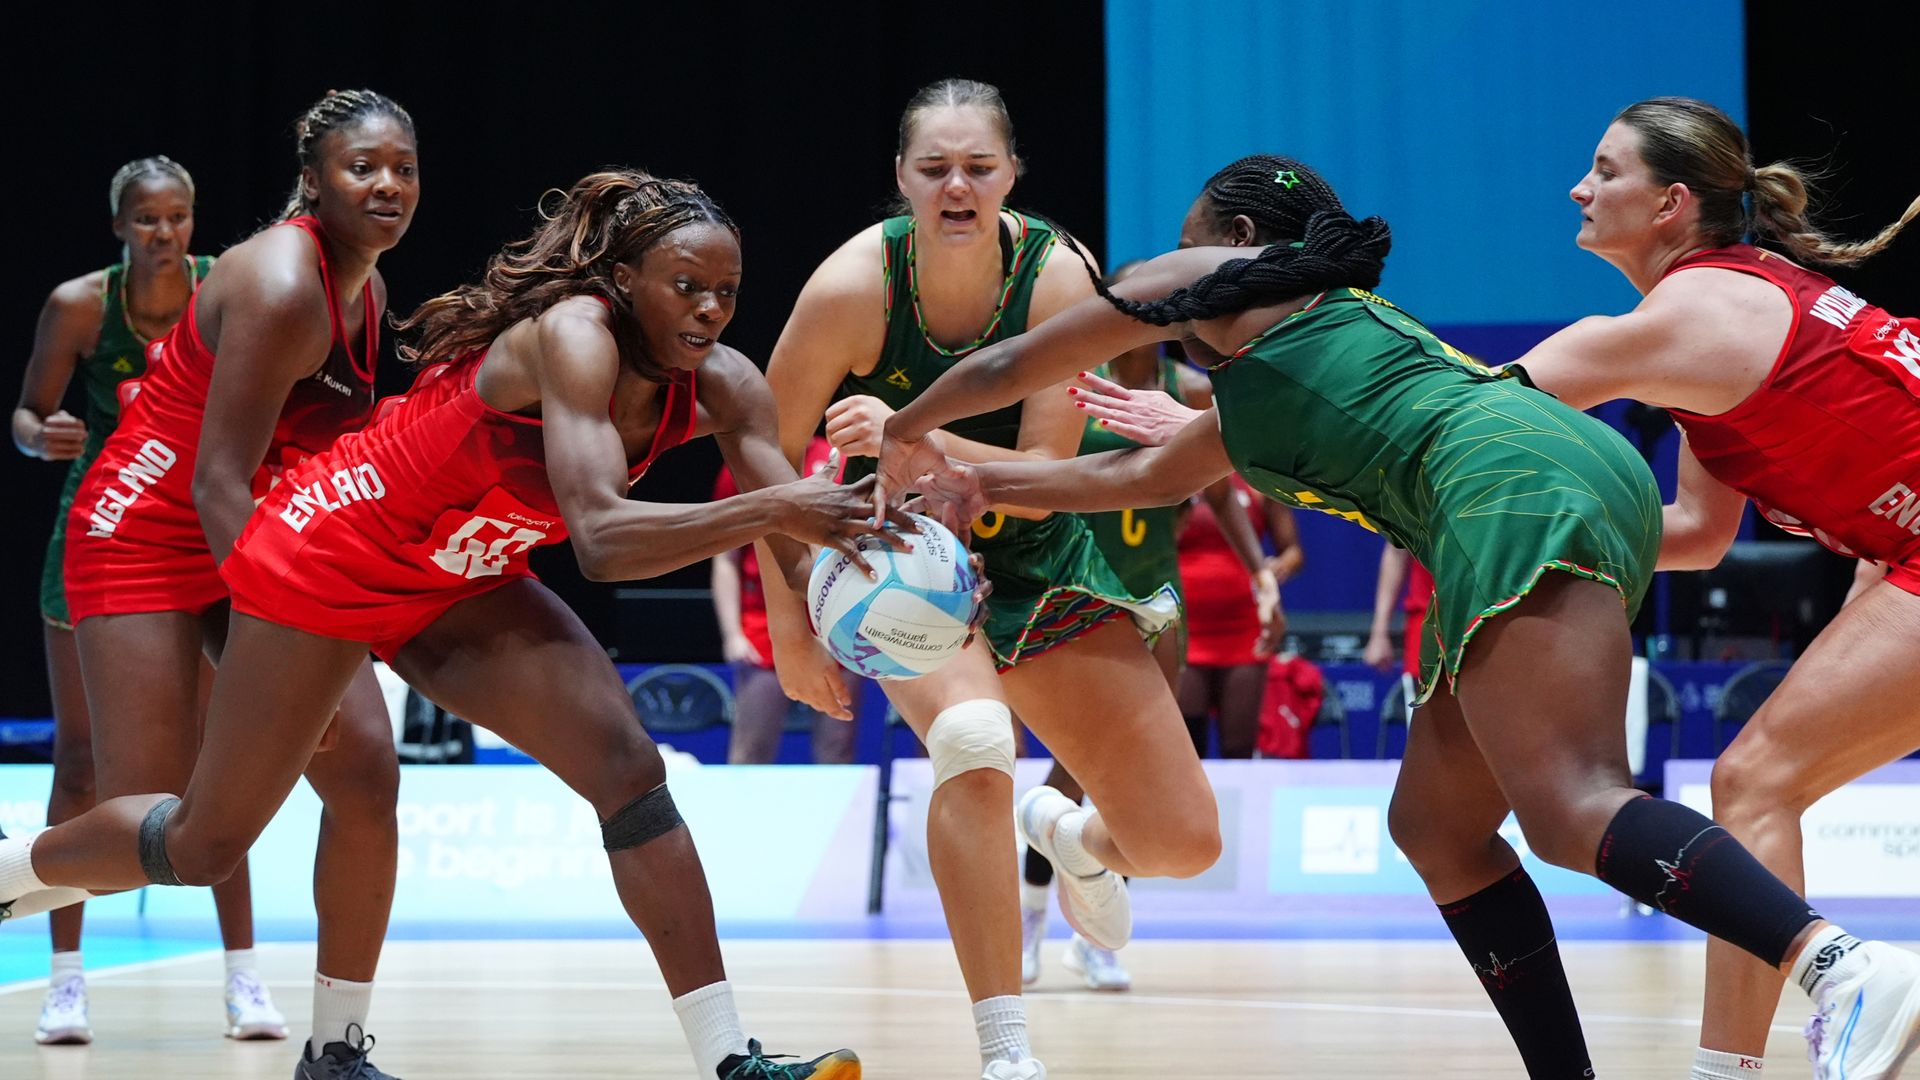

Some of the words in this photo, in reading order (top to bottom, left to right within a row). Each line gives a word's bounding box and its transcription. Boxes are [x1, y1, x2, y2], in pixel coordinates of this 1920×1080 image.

[86, 438, 177, 538] NGLAND
[279, 462, 386, 534] ENLAND
[1867, 481, 1920, 535] EN
[814, 572, 837, 638] LASGOW
[834, 542, 868, 574] 206
[864, 625, 943, 652] commonwealth
[890, 627, 928, 643] games
[397, 799, 496, 837] port
